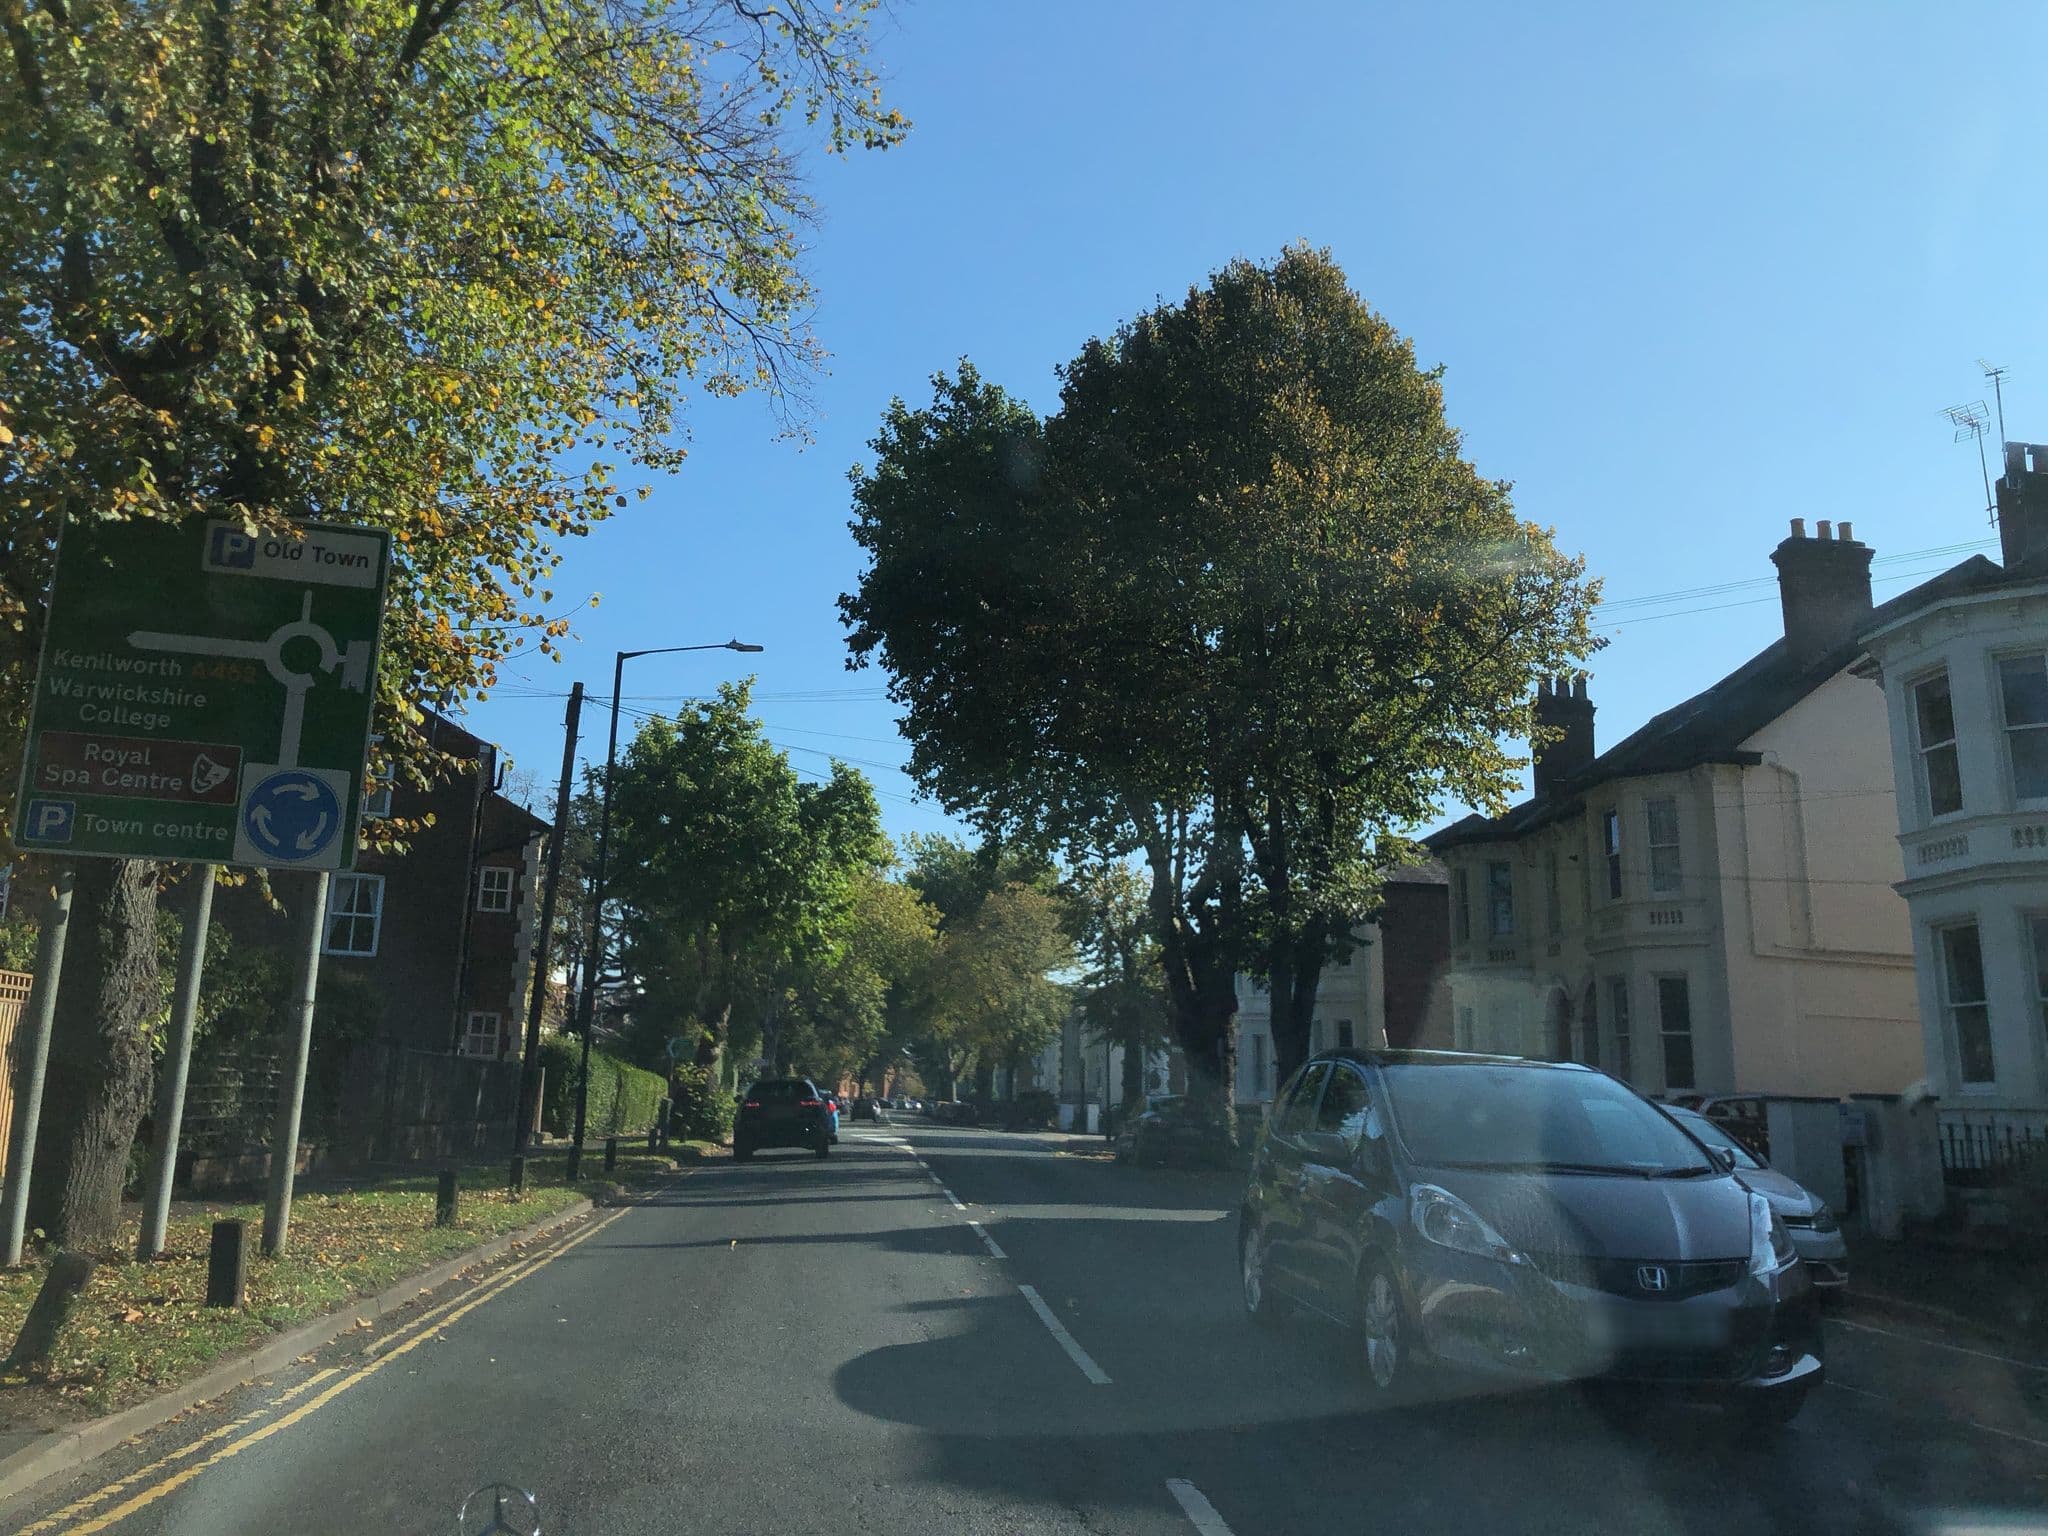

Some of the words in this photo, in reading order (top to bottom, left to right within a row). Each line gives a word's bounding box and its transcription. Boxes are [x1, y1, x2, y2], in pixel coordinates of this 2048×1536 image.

[263, 540, 304, 560] Old
[312, 546, 369, 568] Town
[53, 648, 183, 676] Kenilworth
[50, 676, 208, 708] Warwickshire
[79, 703, 171, 730] College
[84, 743, 151, 767] Royal
[45, 763, 91, 786] Spa
[102, 767, 184, 791] Centre
[38, 805, 67, 836] P
[84, 813, 144, 835] Town
[152, 821, 229, 841] centre
